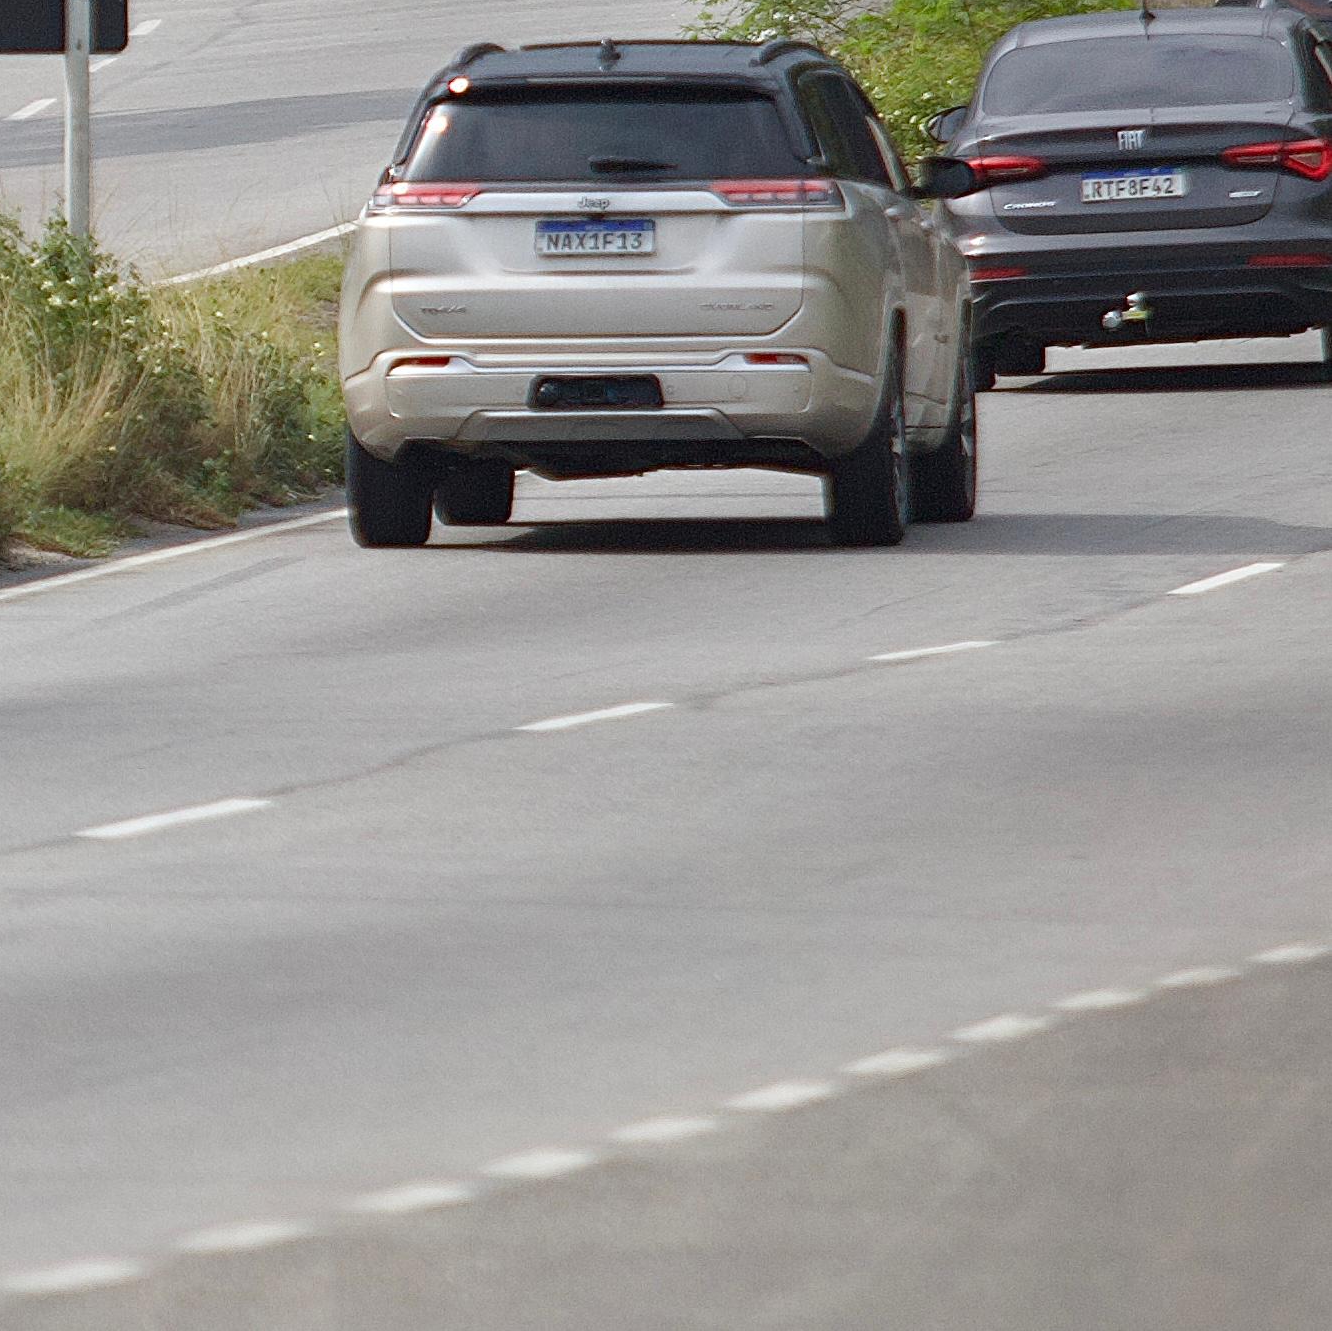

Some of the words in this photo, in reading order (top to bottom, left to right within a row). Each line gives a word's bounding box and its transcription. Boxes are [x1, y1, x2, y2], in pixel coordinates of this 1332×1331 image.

[1117, 129, 1147, 150] FIAT
[1092, 177, 1174, 199] RTF8F42
[578, 196, 610, 210] Jeep
[547, 232, 642, 250] NAX1F13
